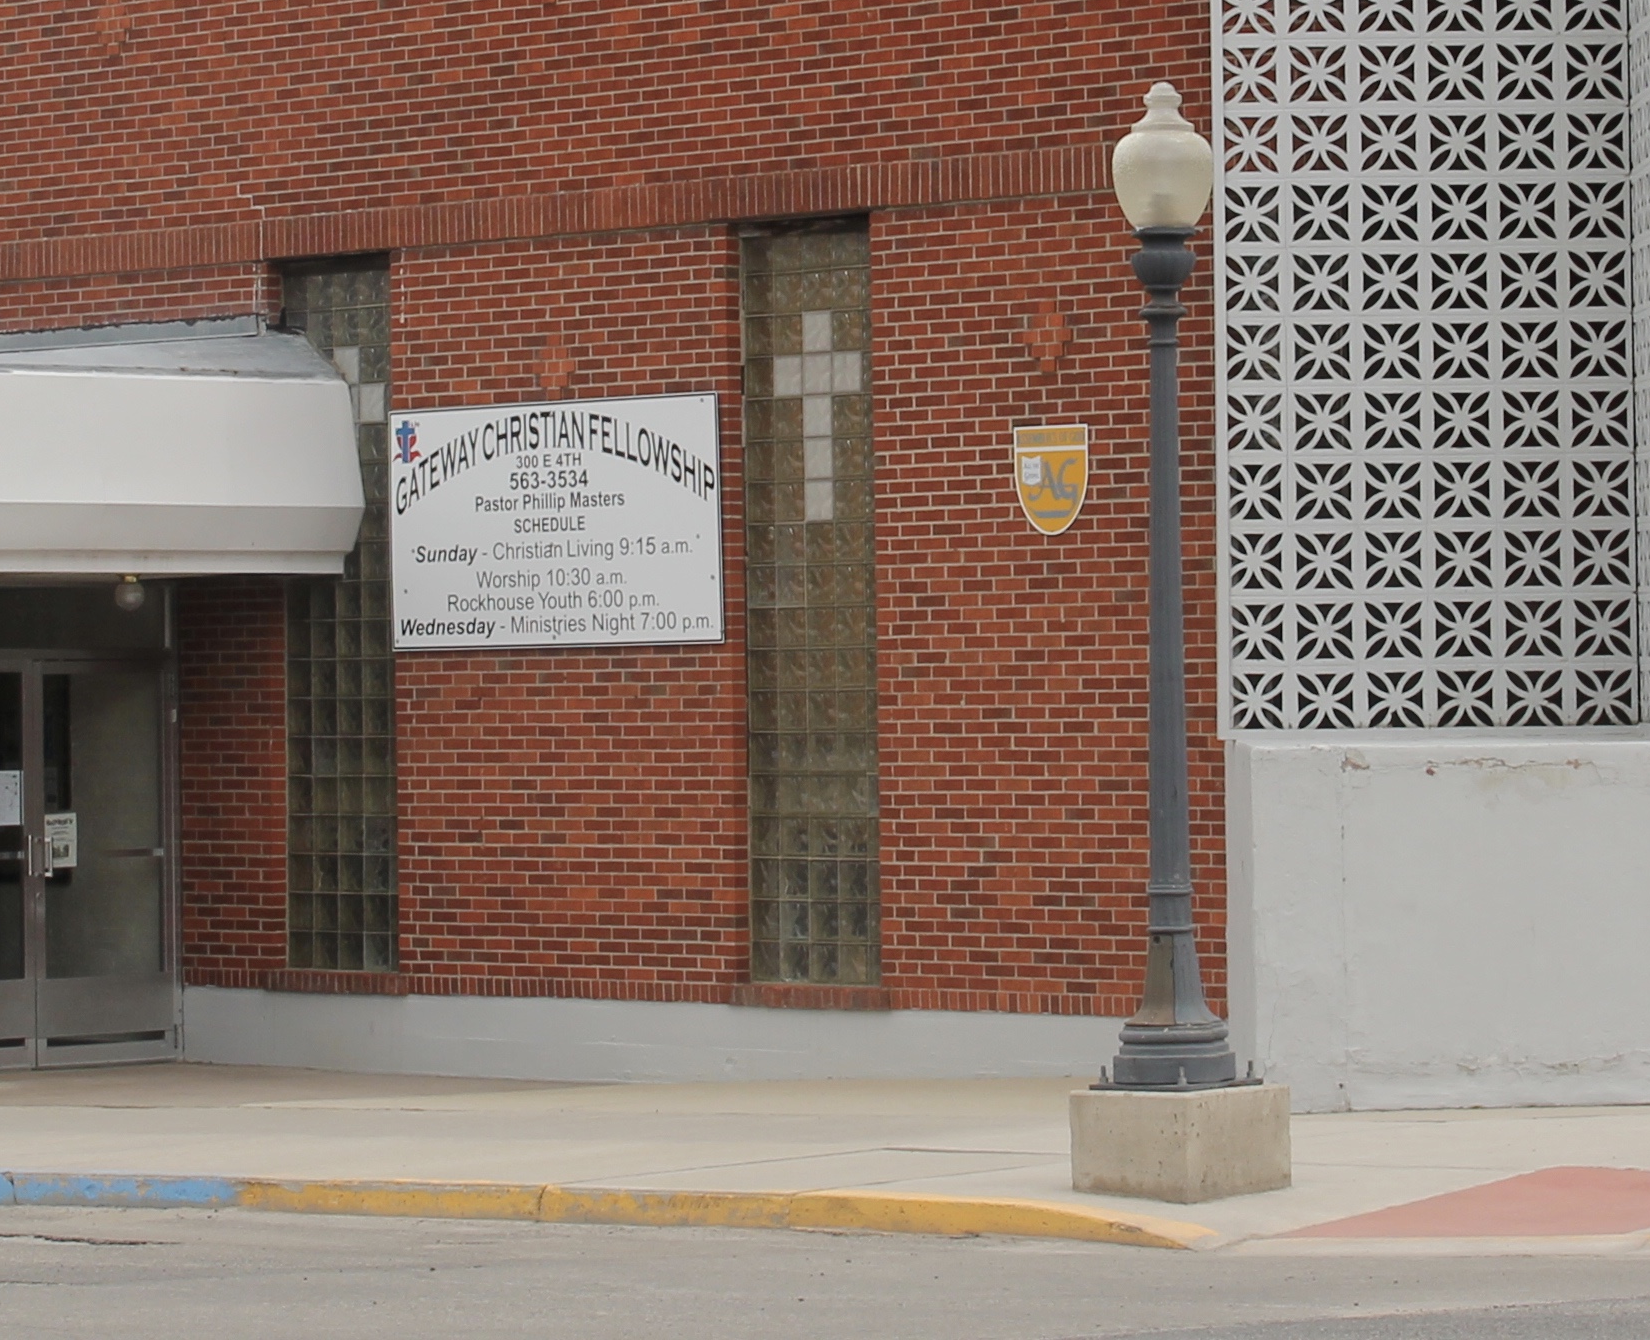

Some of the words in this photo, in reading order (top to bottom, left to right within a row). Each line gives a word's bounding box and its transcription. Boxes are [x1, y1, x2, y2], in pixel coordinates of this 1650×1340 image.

[396, 427, 479, 515] GATEWAY
[482, 411, 585, 460] CHRISTIAN
[589, 413, 715, 501] FELLOWSHIP
[516, 455, 539, 469] 300
[543, 454, 551, 468] E
[556, 452, 582, 467] 4TH
[509, 469, 589, 490] 563-3534
[475, 494, 519, 513] Pastor
[522, 491, 565, 512] Phillip
[570, 491, 625, 509] Masters
[514, 516, 586, 533] SCHEDULE
[415, 544, 478, 566] Sunday
[493, 541, 563, 561] Christian
[567, 538, 614, 561] Living
[619, 536, 656, 556] 9:15
[661, 540, 693, 554] a.m.
[476, 569, 541, 591] Worship
[546, 567, 591, 587] 10:30
[596, 572, 628, 585] a.m.
[447, 593, 535, 612] Rockhouse
[538, 590, 582, 609] Youth
[588, 589, 624, 608] 6:00
[629, 593, 660, 610] p.m.
[401, 616, 496, 639] Wednesday
[511, 614, 587, 635] Ministries
[592, 612, 636, 636] Night
[640, 611, 677, 630] 7:00
[682, 615, 714, 633] p.m.
